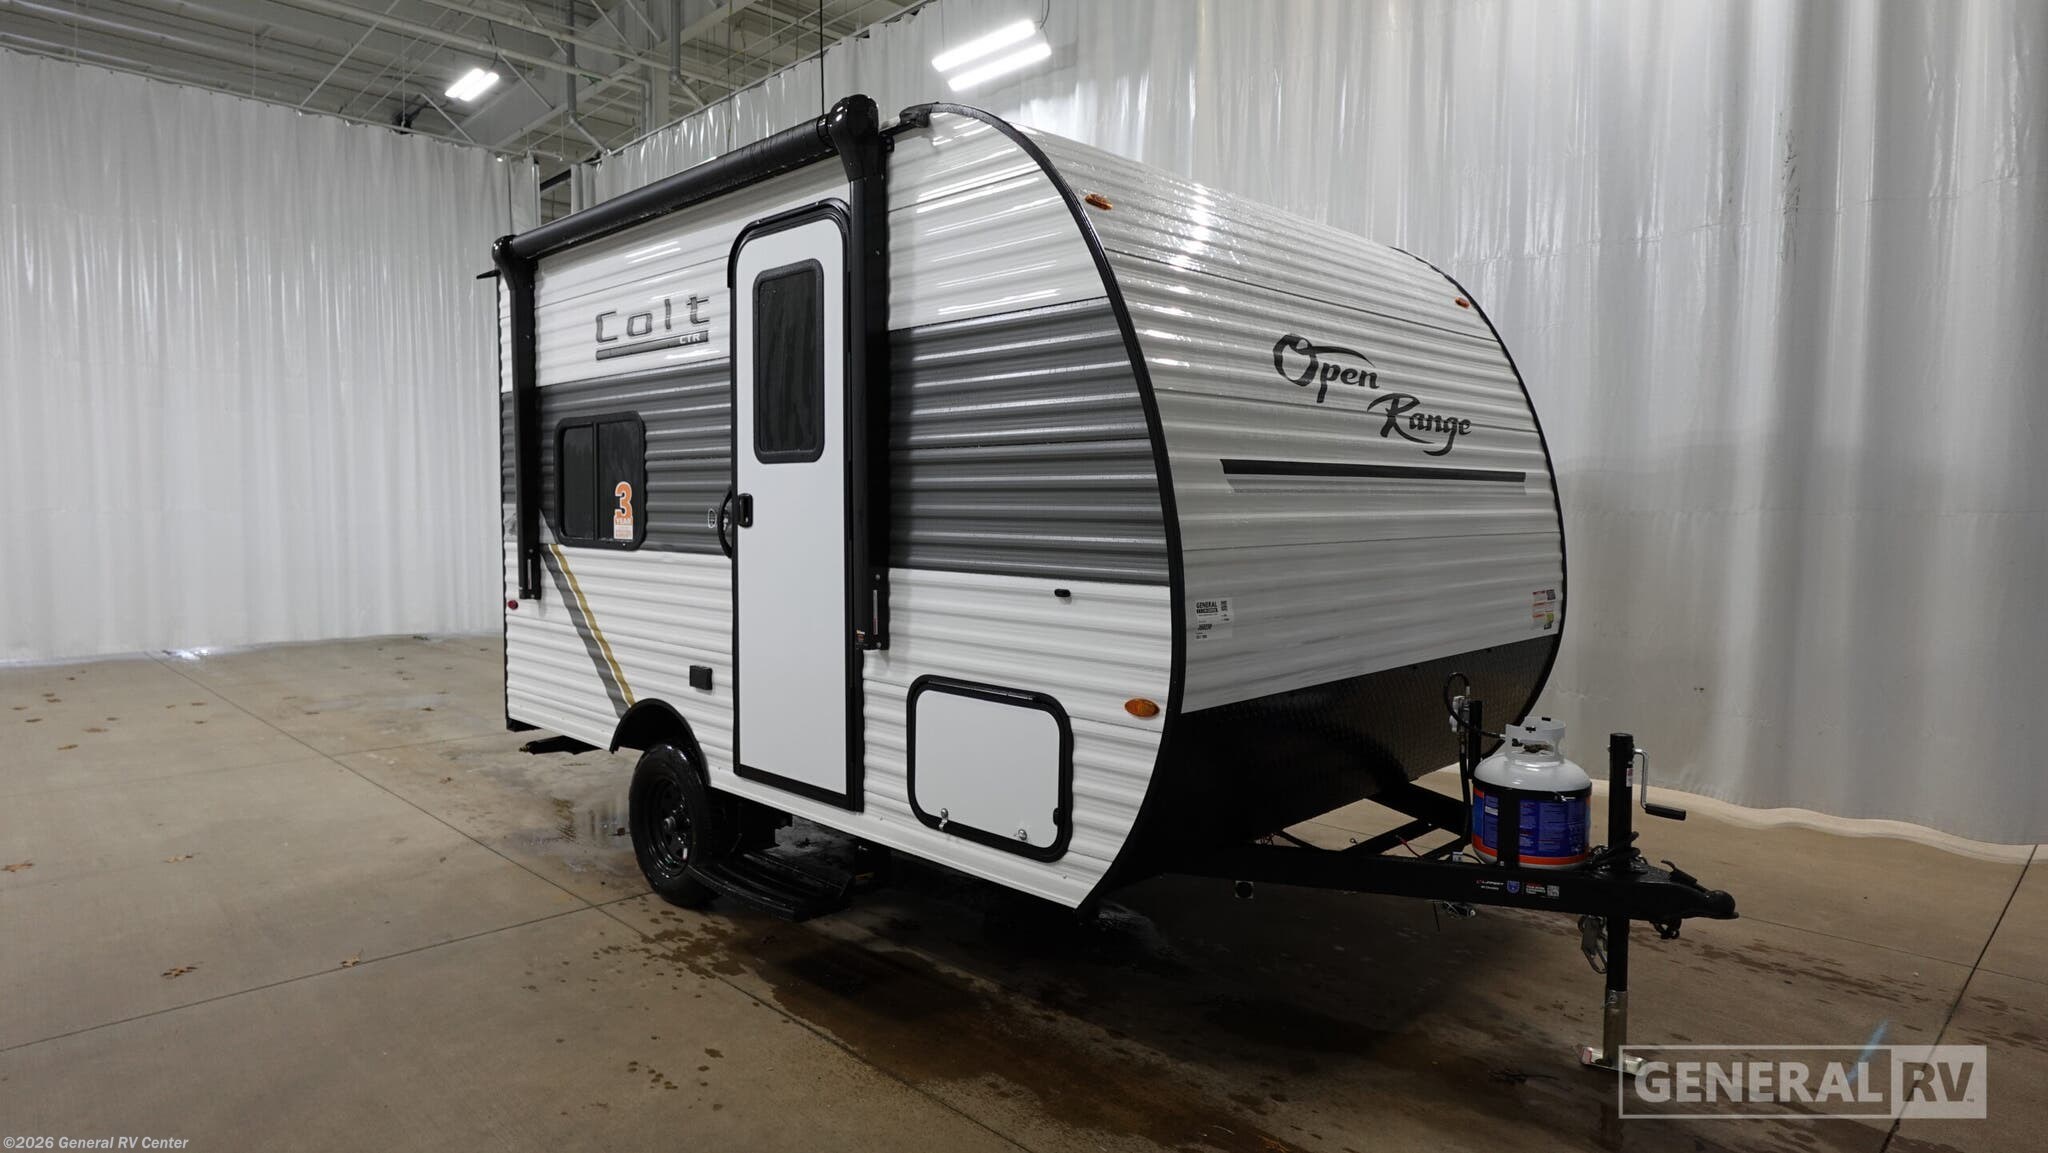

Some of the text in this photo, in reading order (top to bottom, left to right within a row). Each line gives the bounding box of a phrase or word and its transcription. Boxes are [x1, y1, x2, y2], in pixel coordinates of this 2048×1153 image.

[596, 296, 709, 343] Colt
[679, 333, 700, 344] CTR
[1273, 334, 1379, 404] Open
[1367, 392, 1472, 457] Range
[614, 481, 633, 519] 3
